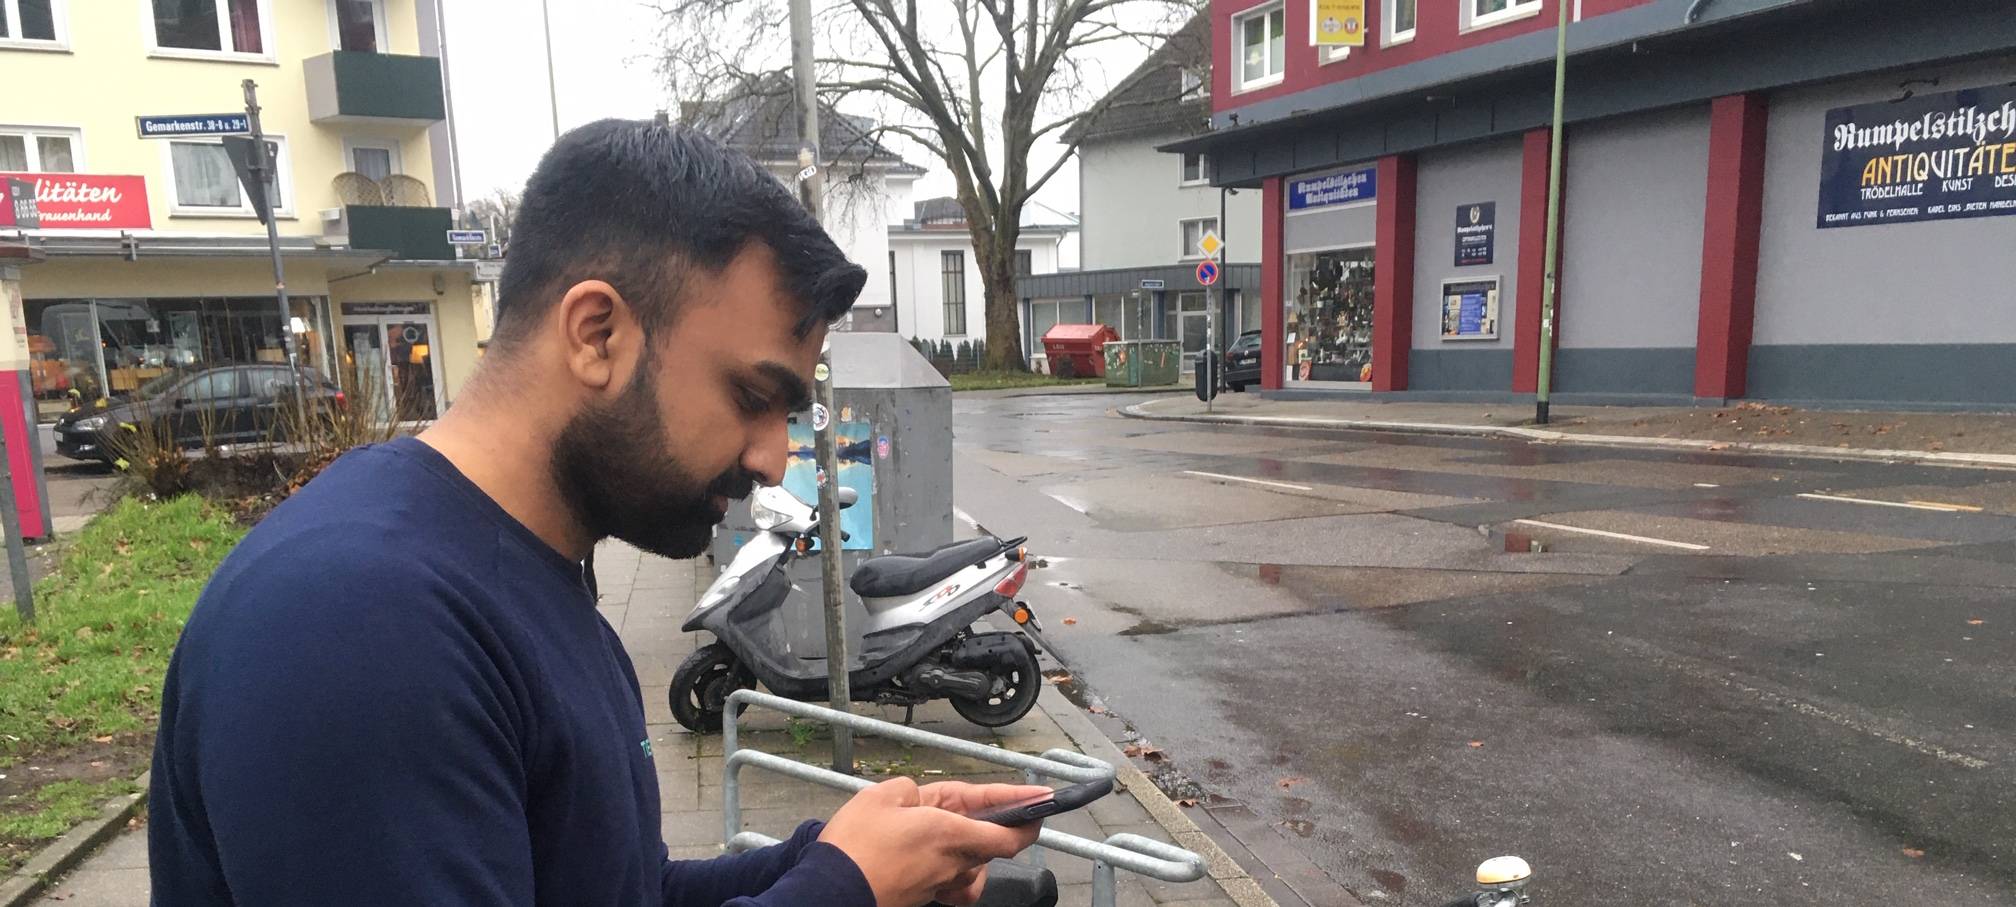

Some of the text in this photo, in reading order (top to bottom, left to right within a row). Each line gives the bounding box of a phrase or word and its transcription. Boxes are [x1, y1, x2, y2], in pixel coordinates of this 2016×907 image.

[146, 121, 206, 132] Gemarkenstr.
[1834, 101, 2016, 151] Rumpelstilzch
[1861, 140, 2016, 187] ANTIQUITÄTE
[1860, 183, 1924, 200] TRÖDELHALLE
[1942, 177, 1973, 193] KUNST
[38, 208, 112, 221] rauenhand
